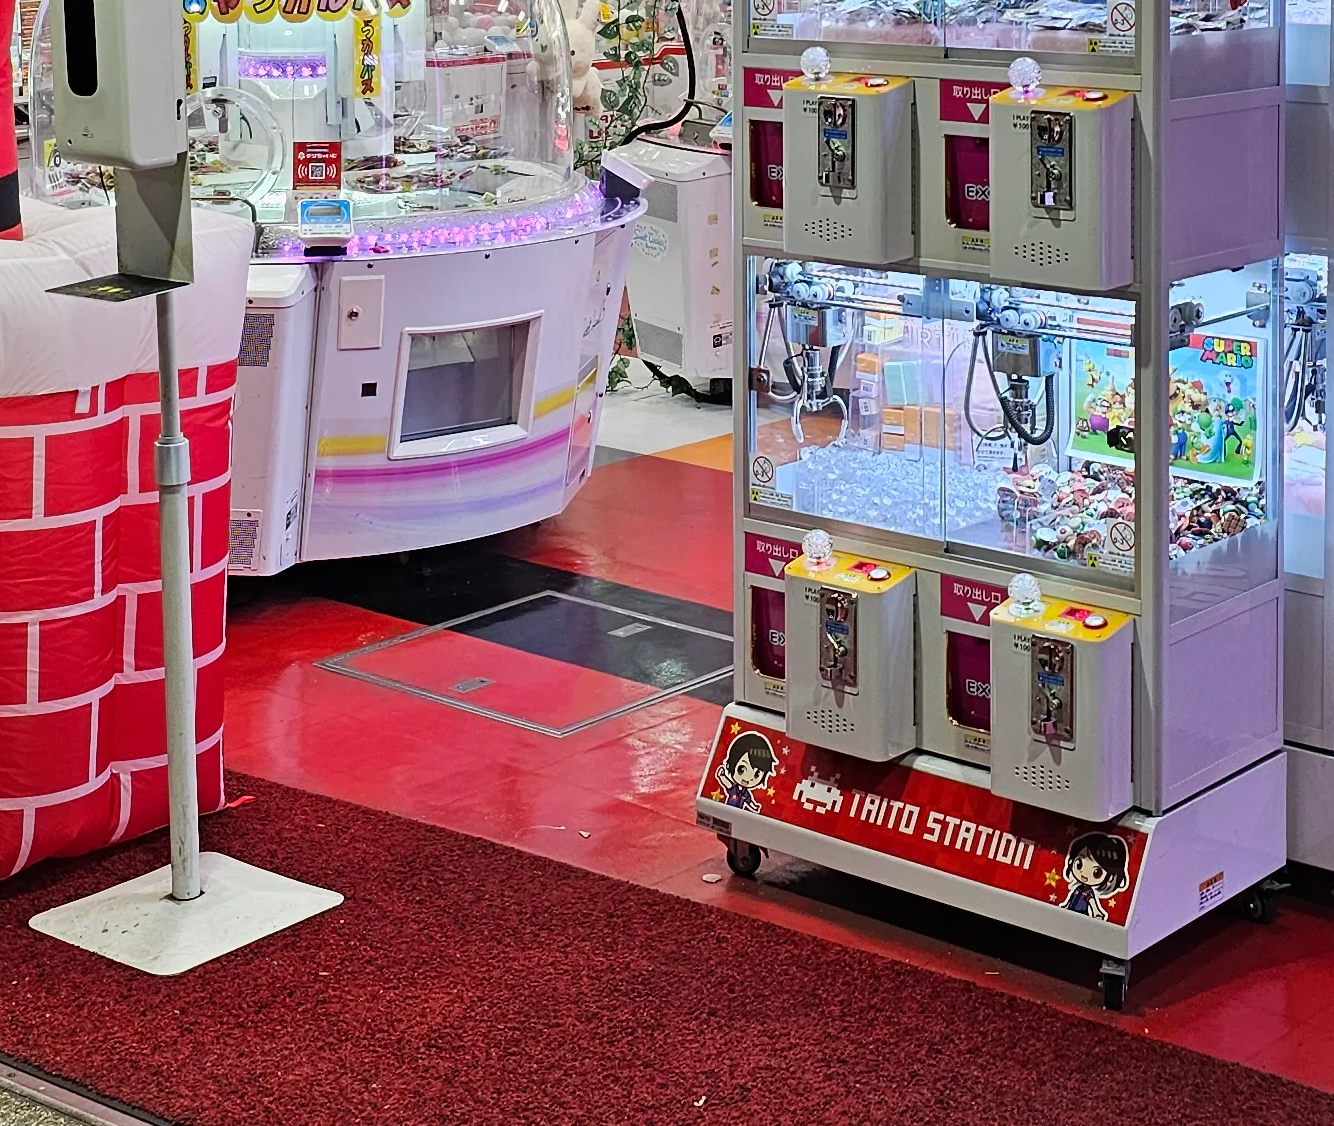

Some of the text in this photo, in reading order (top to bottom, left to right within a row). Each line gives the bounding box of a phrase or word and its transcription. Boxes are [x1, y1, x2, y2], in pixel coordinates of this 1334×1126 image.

[1201, 333, 1253, 358] SUPER
[1199, 349, 1254, 370] MARIO
[756, 539, 799, 558] 取り出し口
[953, 582, 1002, 604] 取り出し口
[849, 788, 1036, 871] TAITO STATION
